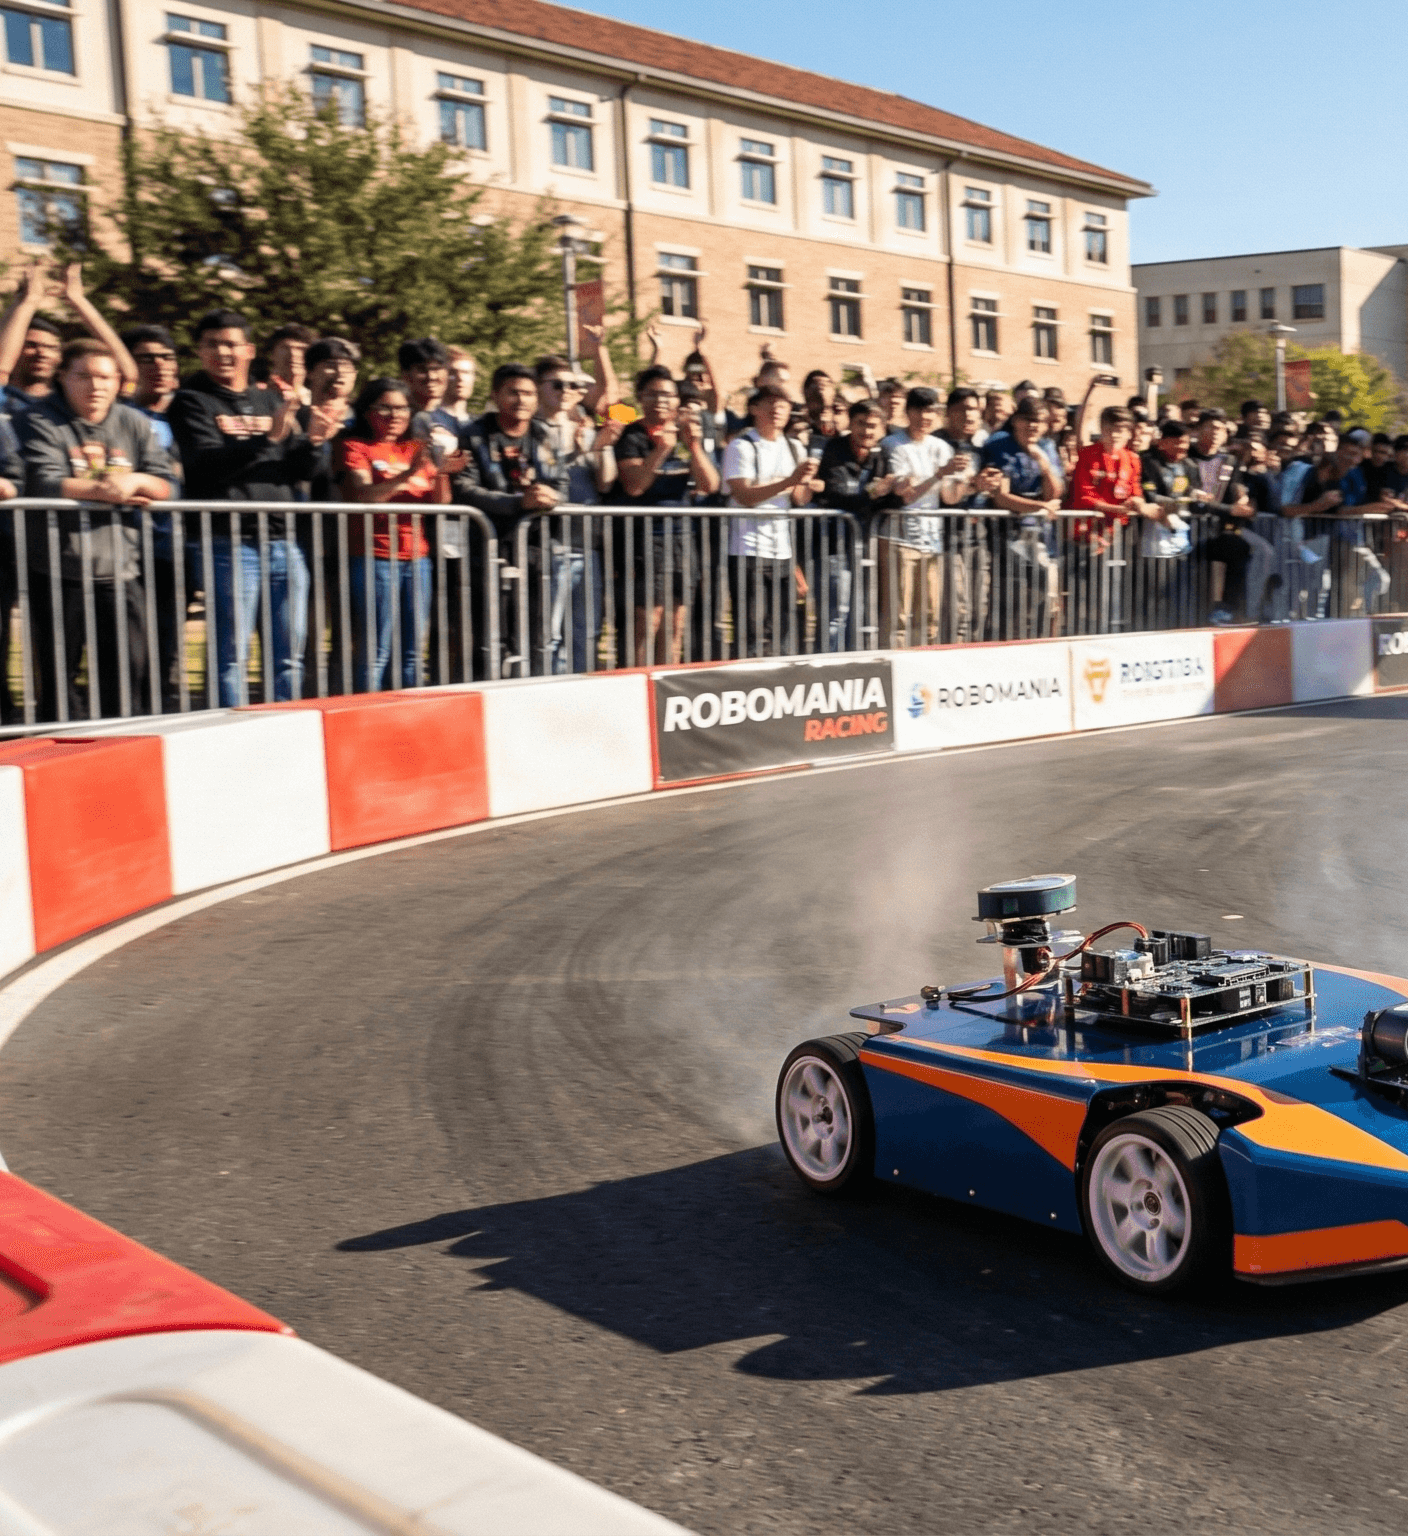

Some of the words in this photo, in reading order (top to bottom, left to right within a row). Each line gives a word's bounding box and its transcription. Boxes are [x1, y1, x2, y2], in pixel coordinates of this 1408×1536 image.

[663, 677, 887, 732] ROBOMANIA
[938, 677, 1062, 708] ROBOMANIA
[804, 711, 888, 741] RACING
